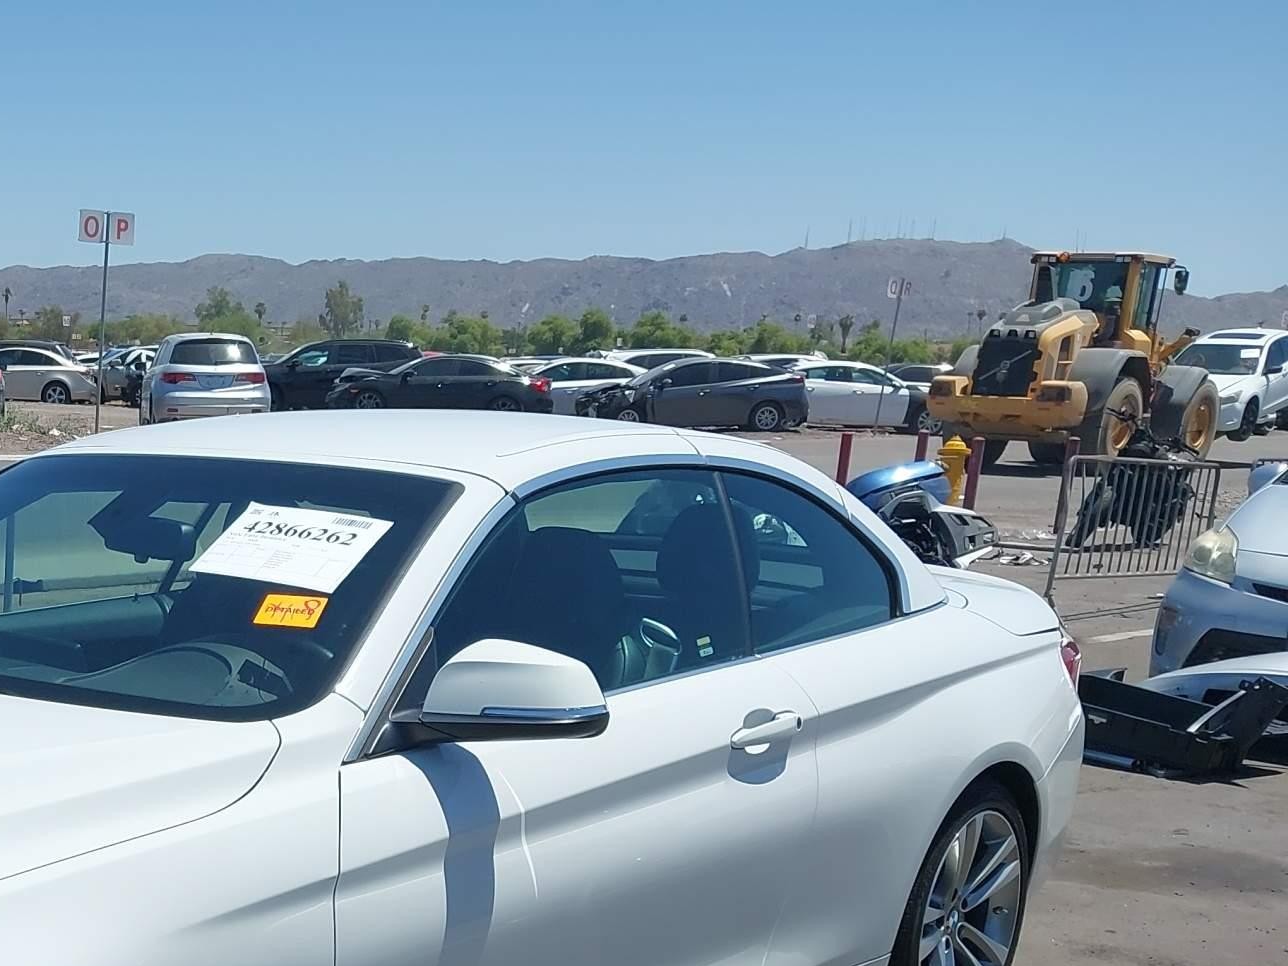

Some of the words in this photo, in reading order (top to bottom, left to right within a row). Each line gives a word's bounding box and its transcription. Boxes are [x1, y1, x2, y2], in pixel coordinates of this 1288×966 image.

[84, 215, 99, 238] O
[116, 218, 129, 240] P
[243, 520, 358, 546] 42866262
